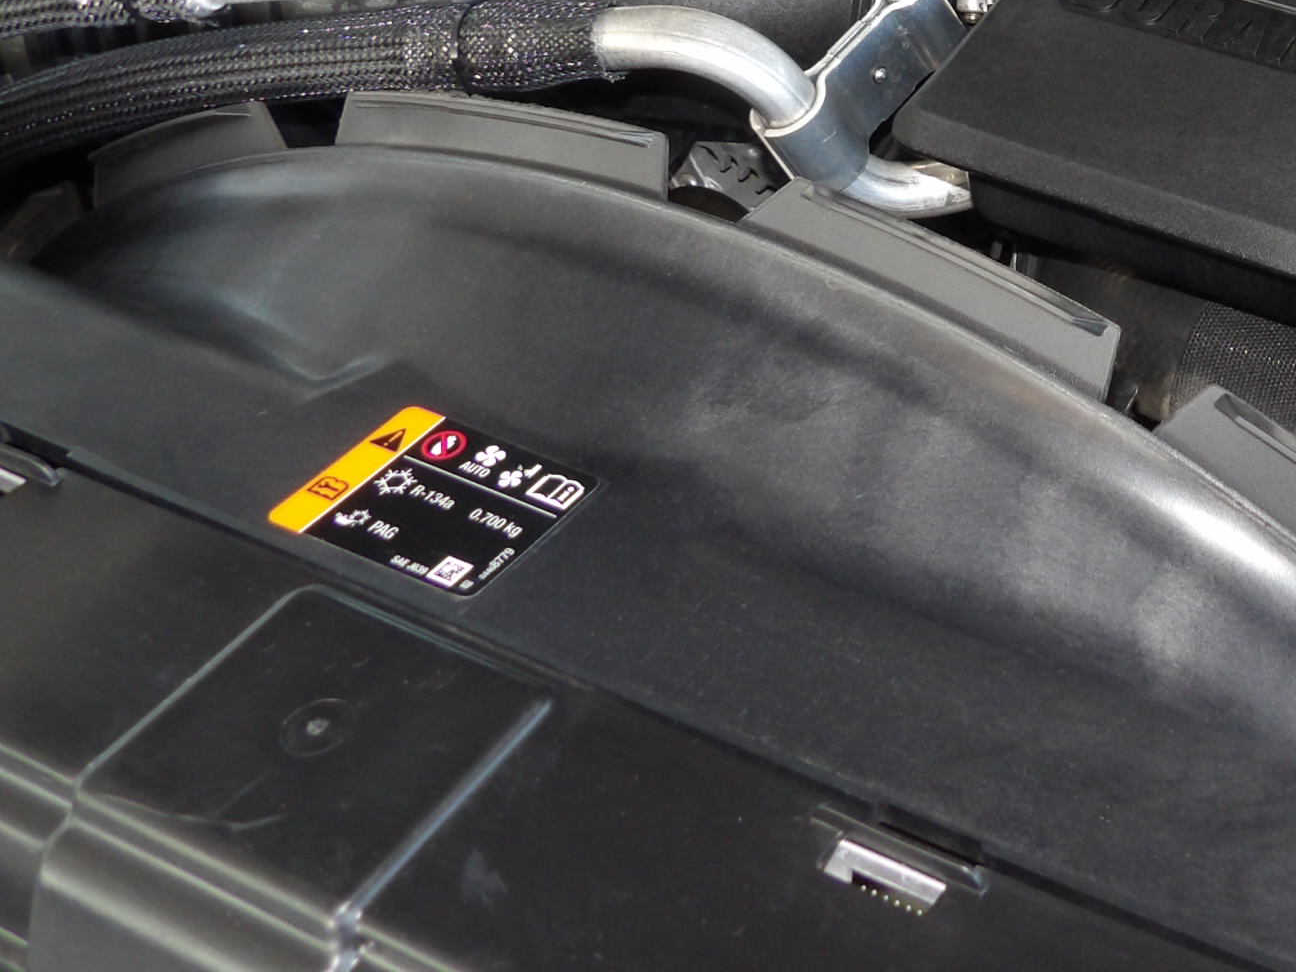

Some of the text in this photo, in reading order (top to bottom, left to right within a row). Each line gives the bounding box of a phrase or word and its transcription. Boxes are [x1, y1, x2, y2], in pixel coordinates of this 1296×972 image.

[458, 460, 491, 478] AUTO
[410, 485, 523, 539] R-134a 0.700 kg
[367, 519, 399, 540] PAG
[389, 554, 411, 568] SAE
